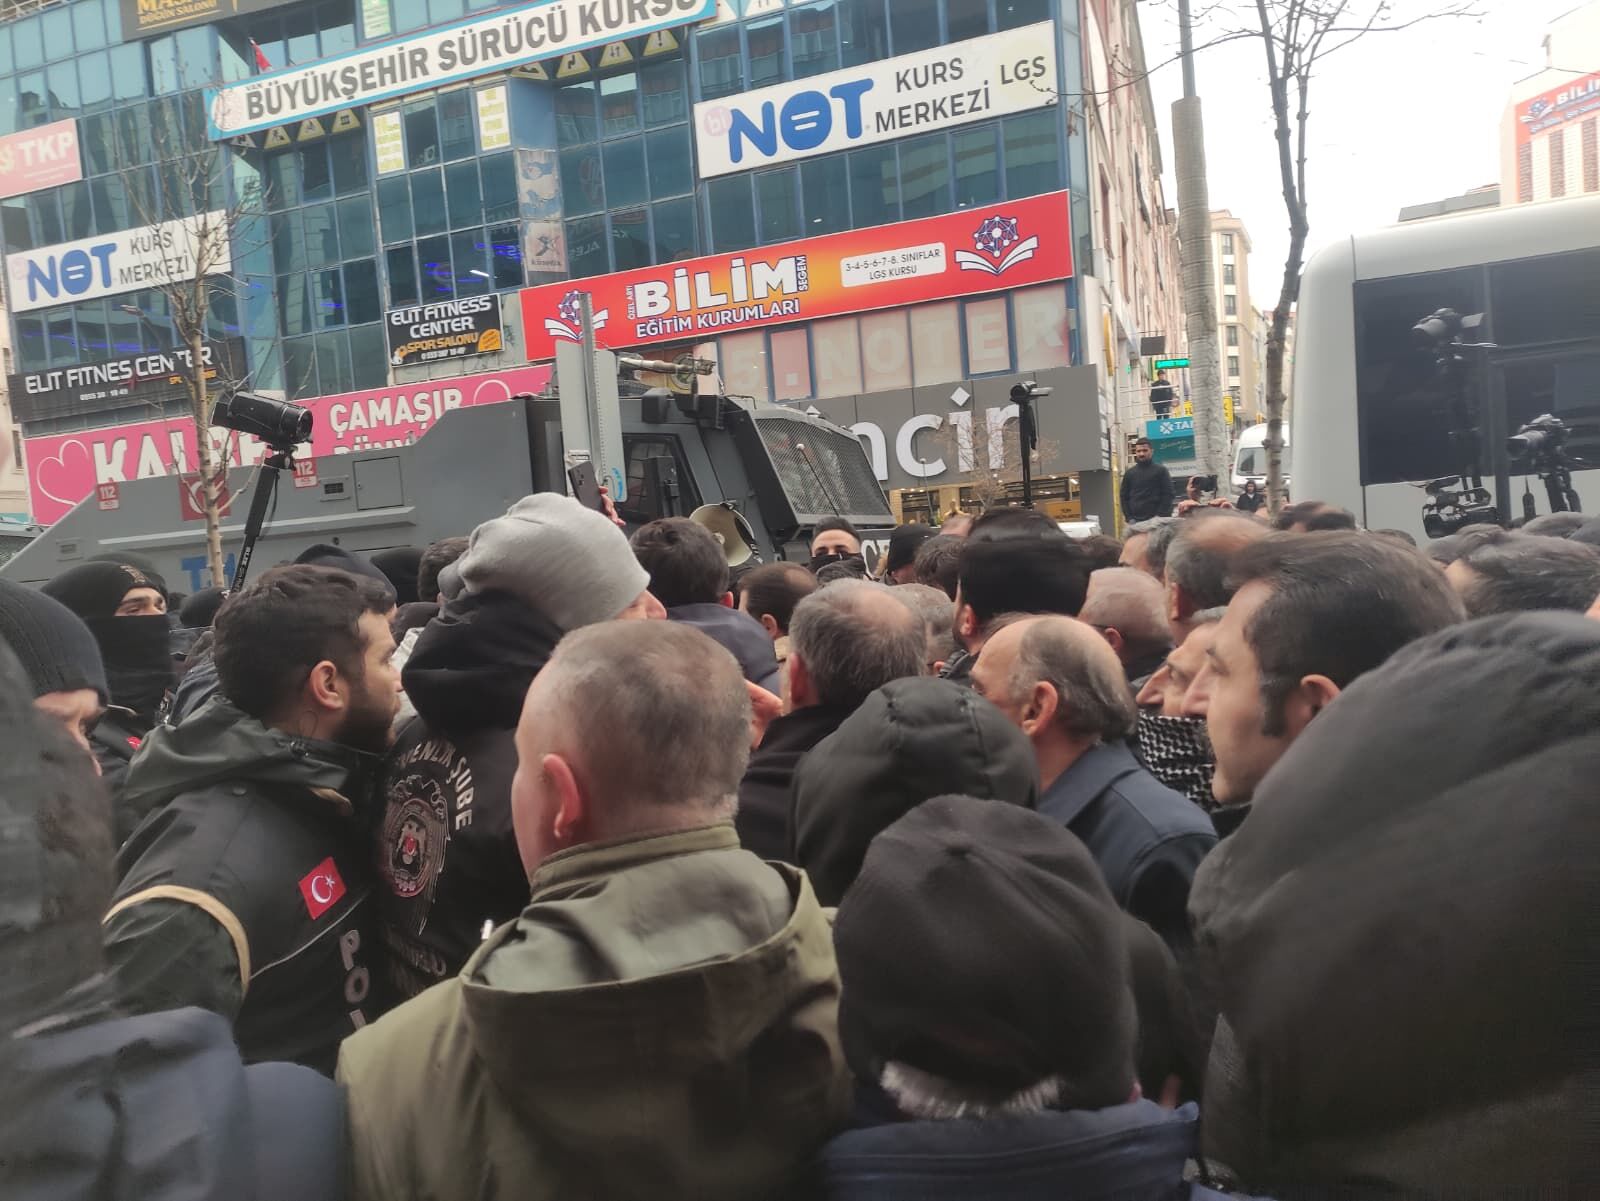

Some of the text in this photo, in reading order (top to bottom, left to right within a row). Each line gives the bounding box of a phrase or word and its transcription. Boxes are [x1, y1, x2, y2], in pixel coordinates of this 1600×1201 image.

[246, 48, 430, 121] BÜYÜKŞEHİR
[437, 4, 569, 73] SÜRÜCÜ
[895, 56, 1047, 93] KURS LGS
[728, 78, 875, 164] NOT
[875, 80, 991, 133] MERKEZİ
[16, 131, 74, 167] TKP
[129, 231, 174, 256] KURS
[901, 248, 941, 263] SINIFLAR
[27, 242, 118, 302] NOT
[119, 250, 190, 285] MERKEZİ
[797, 255, 808, 292] SEGEM
[869, 265, 918, 280] LGS KURSU
[634, 256, 799, 318] BİLİM
[424, 296, 492, 320] FITNESS
[636, 298, 800, 338] EĞİTİM KURUMLARI
[406, 339, 437, 352] SPOR
[436, 332, 479, 348] SALONU
[409, 316, 476, 339] CENTER
[25, 370, 63, 394] ELIT
[66, 359, 132, 388] FITNES
[329, 388, 463, 439] ÇAMAŞIR
[294, 461, 314, 476] 112
[100, 485, 117, 500] 112
[446, 756, 475, 830] ŞUBE
